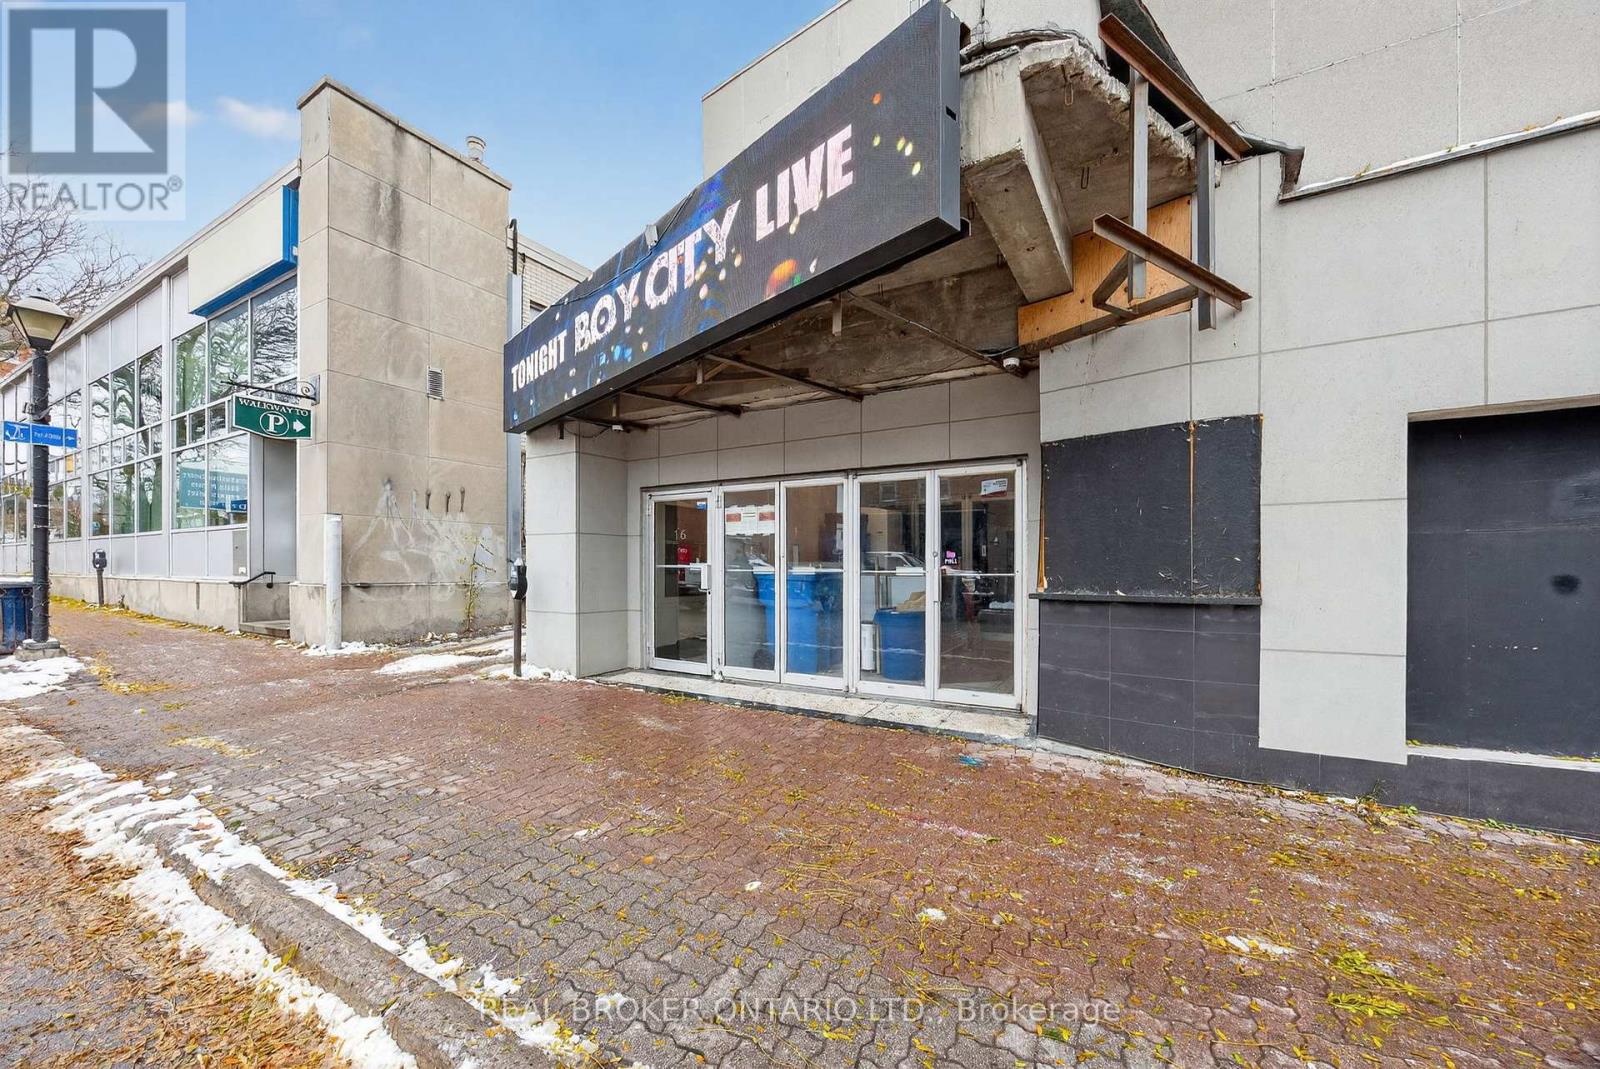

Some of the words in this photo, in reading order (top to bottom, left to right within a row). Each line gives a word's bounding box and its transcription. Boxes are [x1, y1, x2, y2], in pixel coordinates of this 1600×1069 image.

[511, 329, 567, 393] TONIGHT
[756, 123, 853, 242] LIVE
[238, 397, 294, 414] WALKWAY
[294, 407, 309, 417] TO
[266, 413, 286, 433] P
[674, 529, 688, 541] 16
